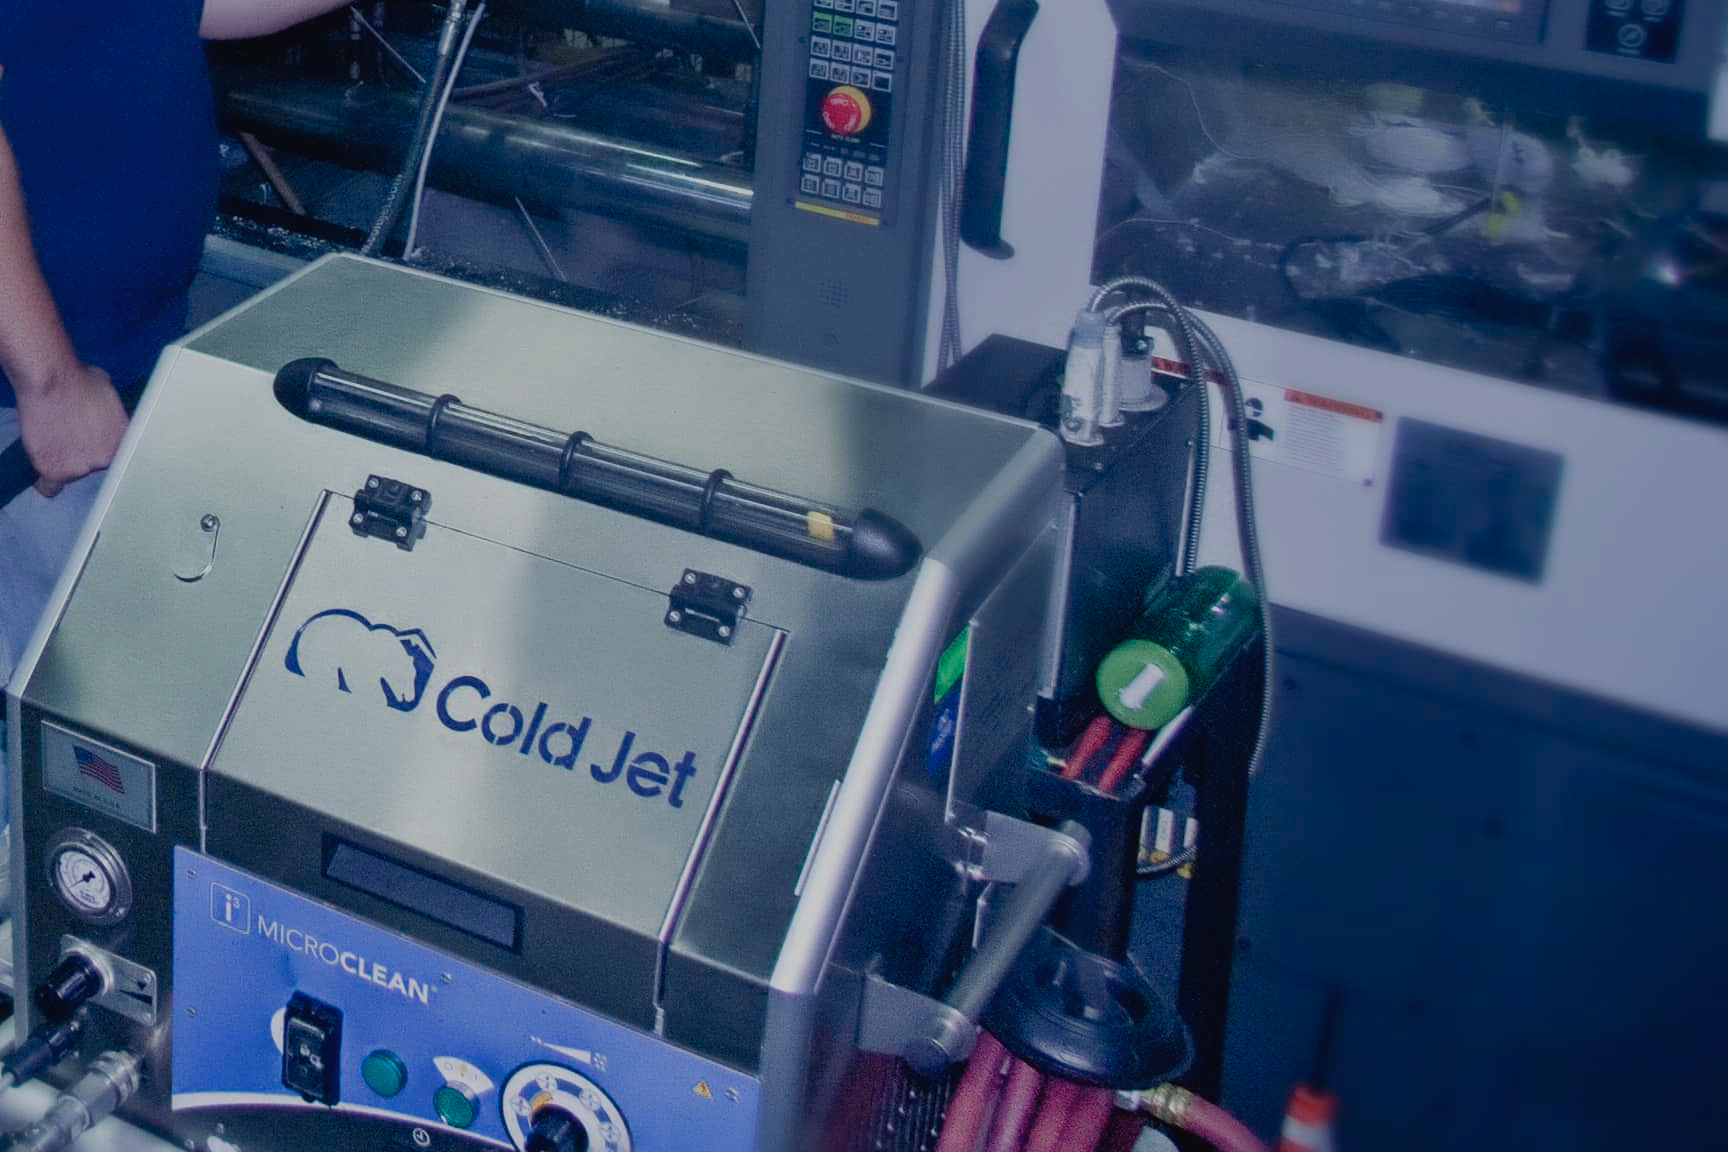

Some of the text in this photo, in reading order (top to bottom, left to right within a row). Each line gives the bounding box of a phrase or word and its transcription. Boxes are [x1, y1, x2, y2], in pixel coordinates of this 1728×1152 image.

[436, 675, 697, 809] Cold Jet
[257, 914, 430, 1006] MICROCLEAN
